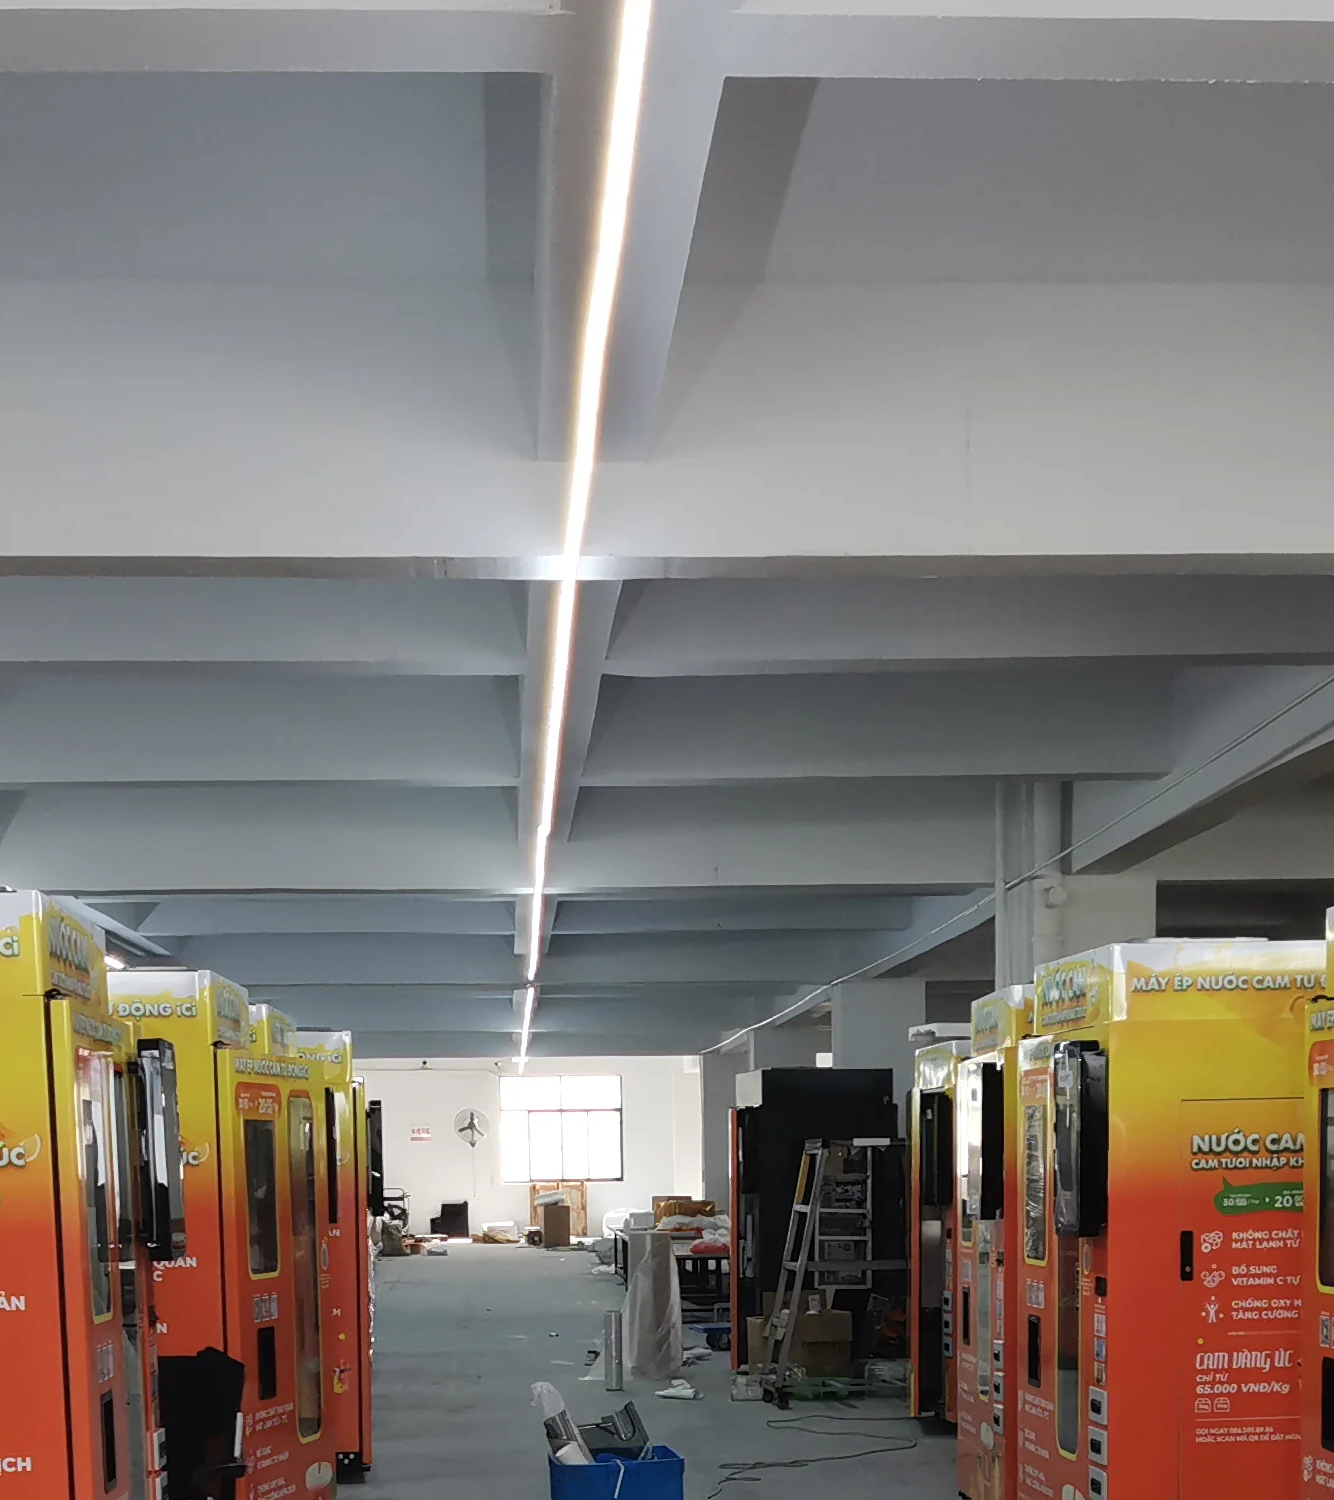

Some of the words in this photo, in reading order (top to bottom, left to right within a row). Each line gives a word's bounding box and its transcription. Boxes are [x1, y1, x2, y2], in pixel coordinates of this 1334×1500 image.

[1131, 973, 1170, 993] MÁY
[1173, 973, 1195, 992] ÉP
[1197, 971, 1249, 991] NƯỚC
[1252, 974, 1292, 990] CAM
[118, 998, 173, 1021] ĐỘNG
[1190, 1127, 1260, 1154] NƯỚC
[1191, 1158, 1219, 1170] CAM
[1221, 1157, 1250, 1169] TƯƠI
[1251, 1156, 1287, 1171] NHẬP
[1232, 1230, 1270, 1241] KHÔNG
[1256, 1240, 1284, 1251] LẠNH
[1248, 1265, 1277, 1274] SUNG
[1232, 1276, 1274, 1286] VITAMIN
[1232, 1297, 1268, 1308] CHỐNG
[1195, 1352, 1228, 1369] CAM
[1232, 1348, 1271, 1373] VÀNG
[1274, 1348, 1293, 1367] ÚC
[1196, 1383, 1238, 1395] 65.000
[1241, 1381, 1290, 1394] VNĐ/Kg
